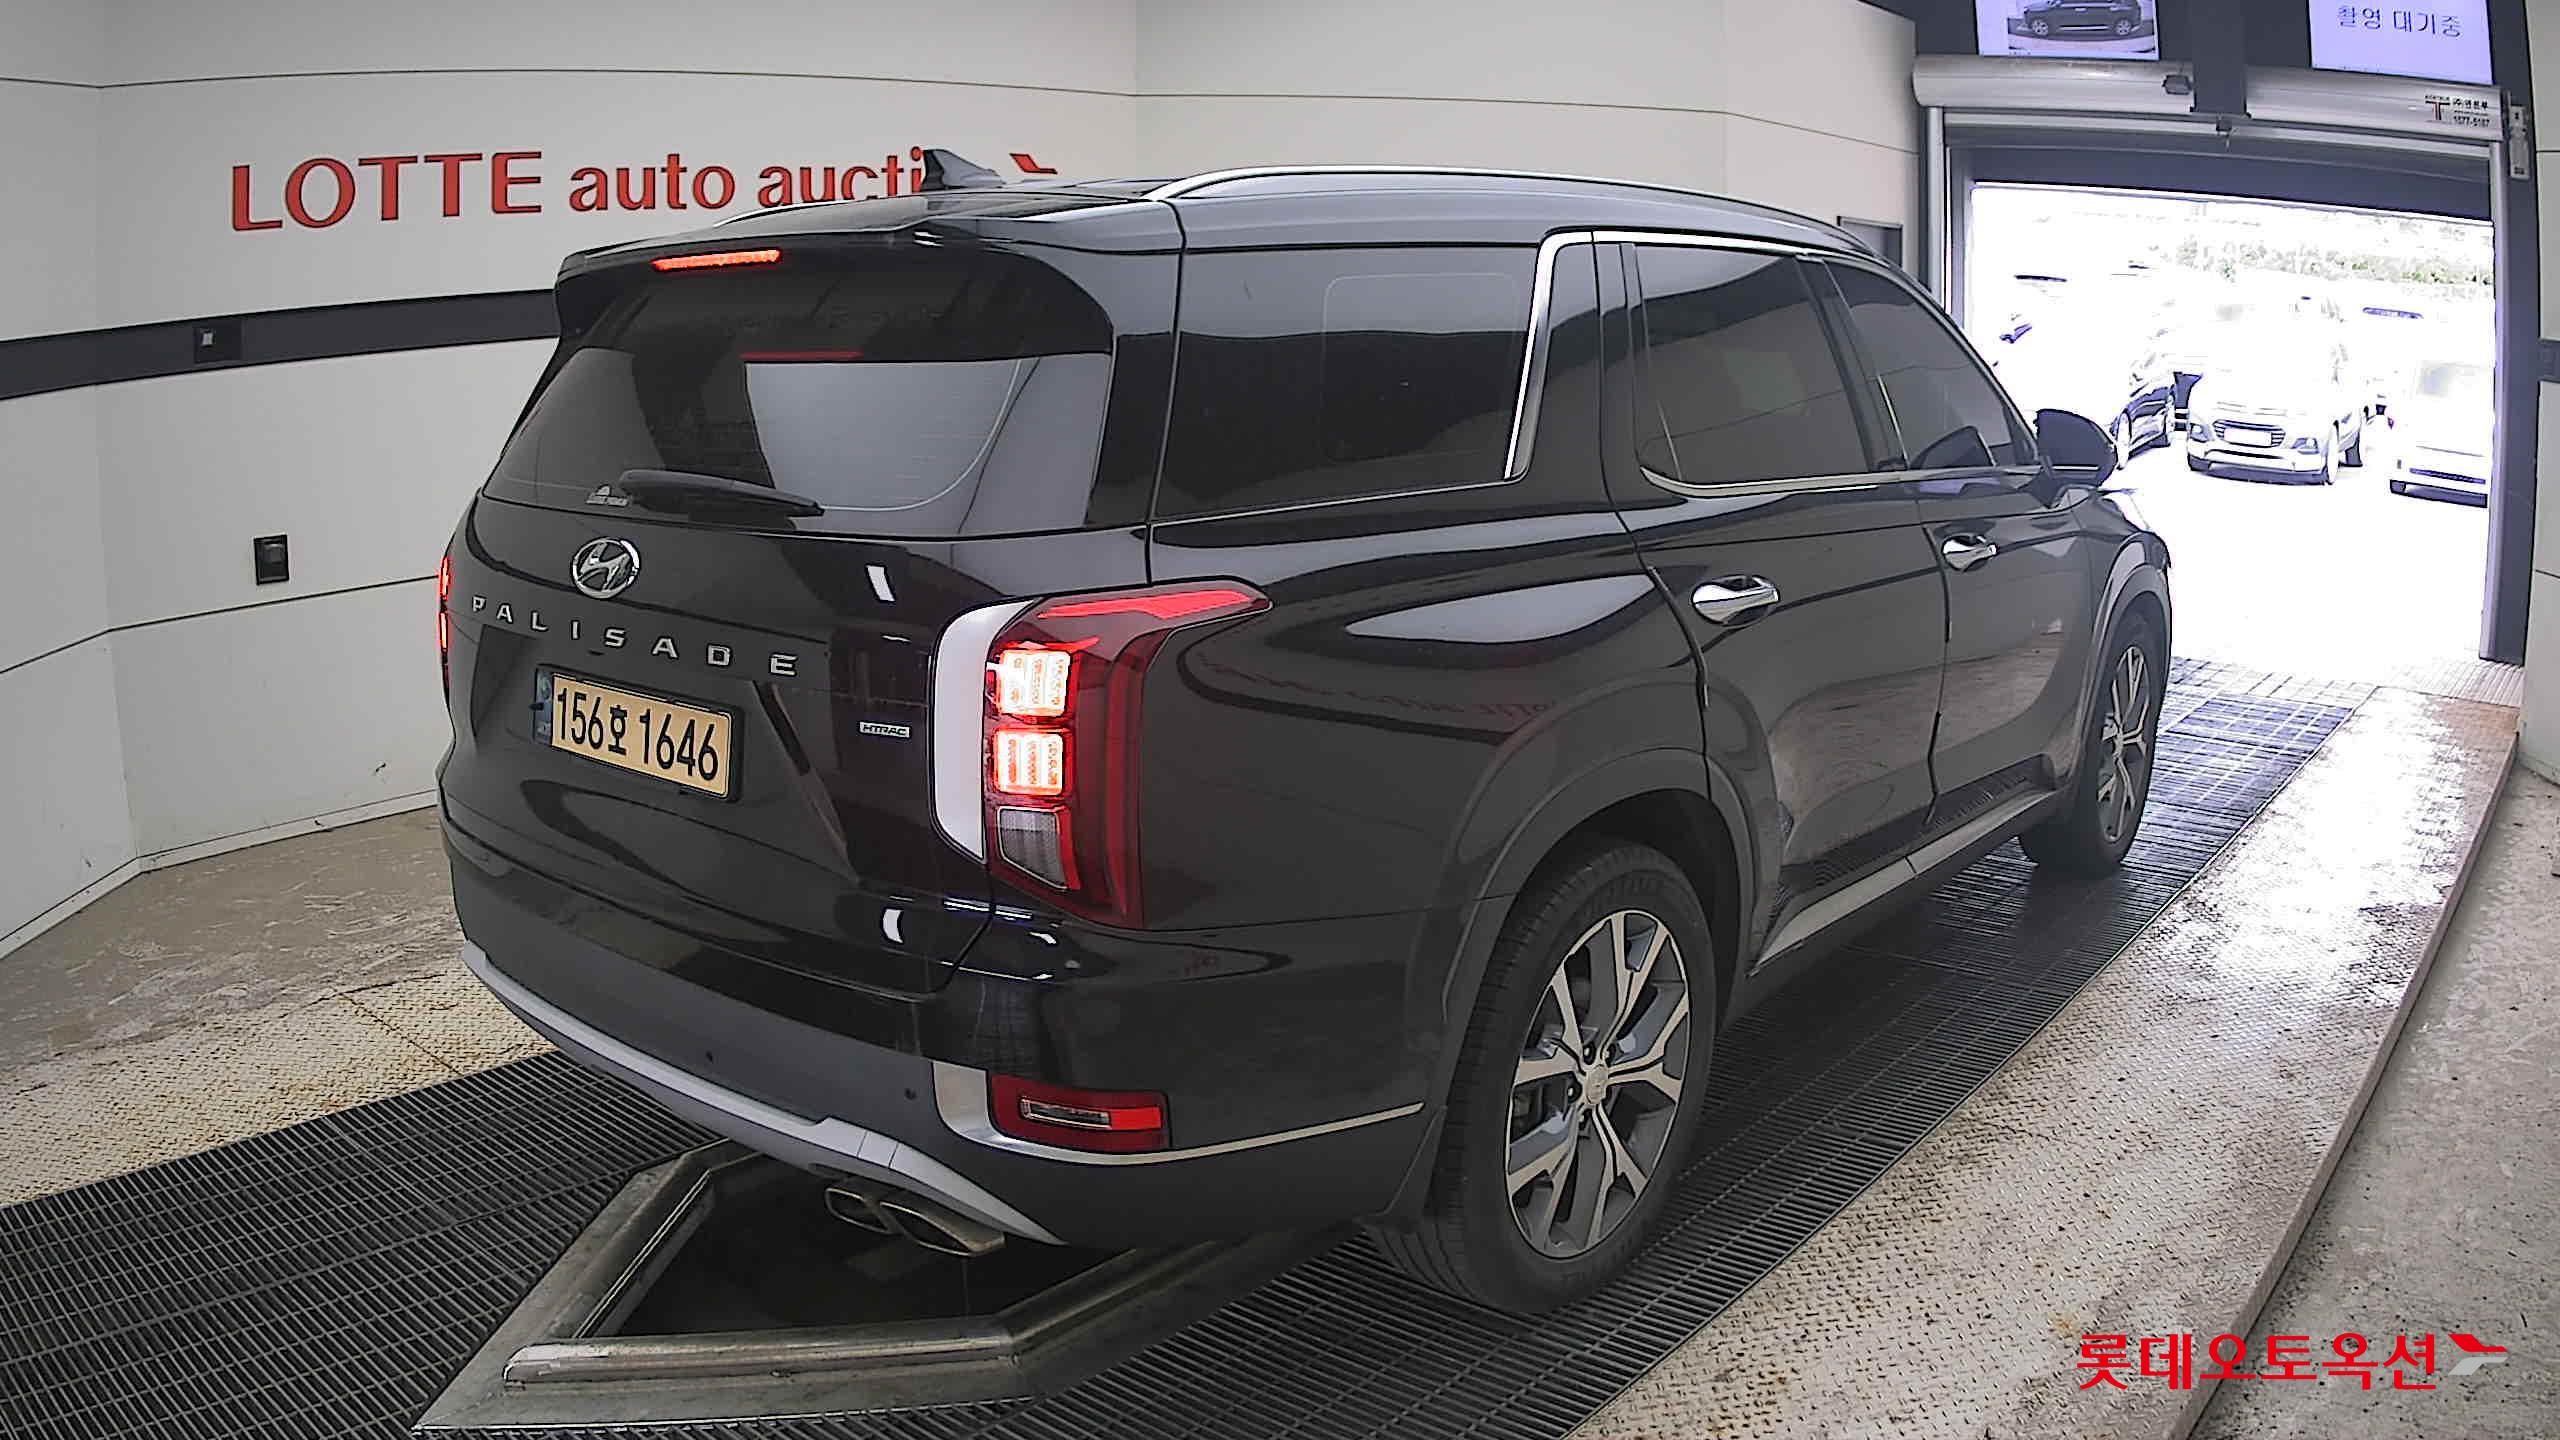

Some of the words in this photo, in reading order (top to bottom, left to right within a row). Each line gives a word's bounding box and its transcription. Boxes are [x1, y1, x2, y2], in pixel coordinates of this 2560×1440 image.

[2338, 6, 2381, 29] 촬영
[2393, 11, 2461, 37] 대기중
[232, 151, 542, 231] LOTTE
[568, 153, 736, 212] auto
[757, 147, 924, 207] aucti
[471, 595, 799, 677] PALISADE
[639, 708, 719, 781] 1646
[862, 723, 908, 736] HTRAC
